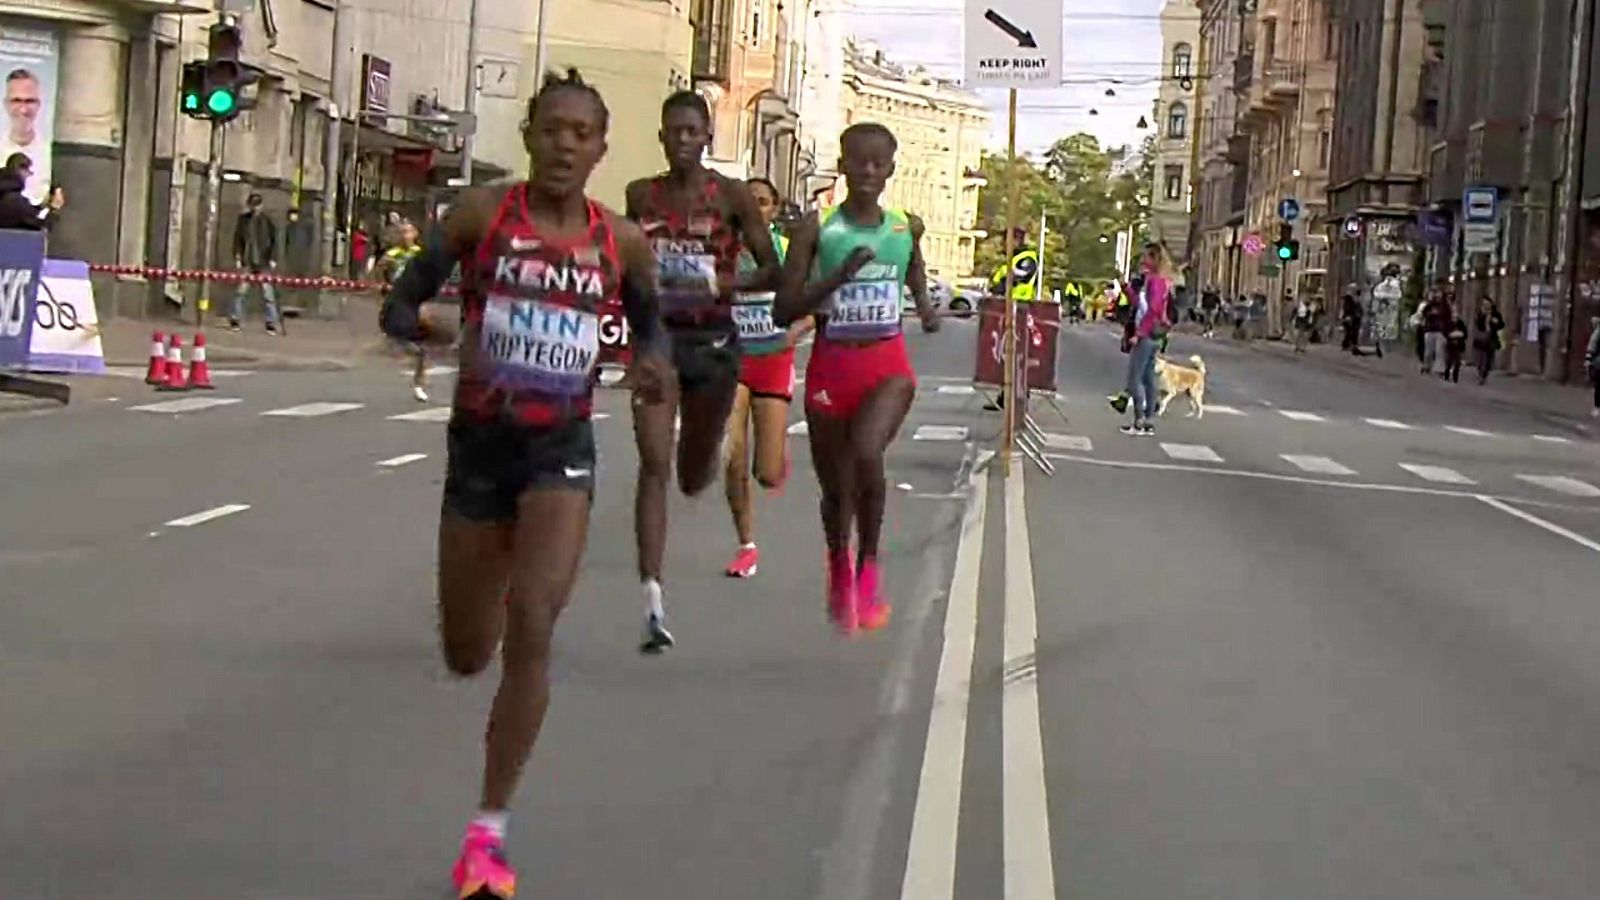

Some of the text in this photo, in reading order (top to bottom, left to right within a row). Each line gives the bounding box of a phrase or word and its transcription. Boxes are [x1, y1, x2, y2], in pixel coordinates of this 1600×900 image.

[979, 58, 1047, 69] KEEP RIGHT
[495, 256, 604, 297] KENYA
[840, 284, 889, 301] NTN
[510, 302, 582, 340] NTN
[488, 331, 593, 373] KIPYEGON
